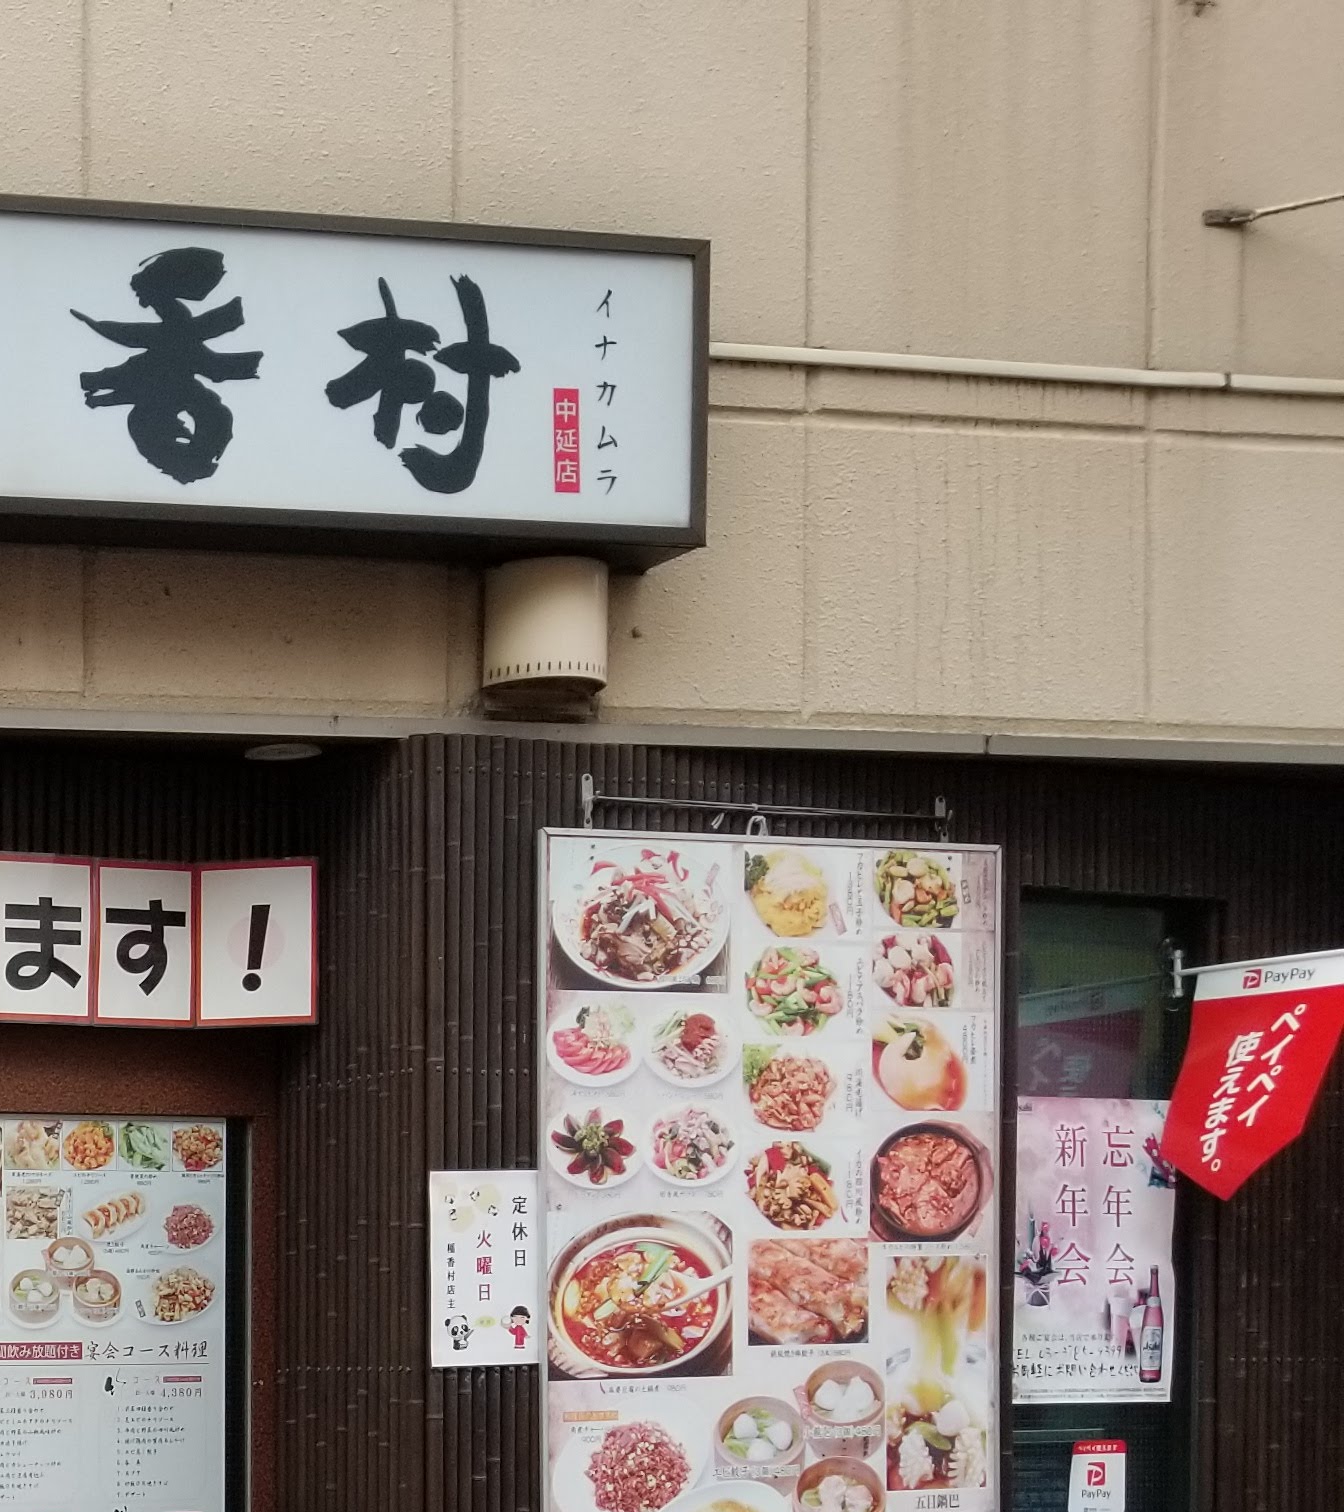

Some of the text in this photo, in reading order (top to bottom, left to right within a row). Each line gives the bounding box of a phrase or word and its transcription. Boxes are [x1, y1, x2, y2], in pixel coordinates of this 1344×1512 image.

[595, 289, 618, 495] イナカムラ
[555, 398, 579, 483] 中延店
[1264, 967, 1316, 985] PayPay
[1199, 1031, 1265, 1173] 使えます。
[1235, 1003, 1309, 1128] ペイペイ
[511, 1196, 528, 1267] 定休日
[1054, 1123, 1091, 1287] 新年会
[1101, 1125, 1135, 1286] 忘年会
[476, 1229, 493, 1302] 火曜日
[85, 1340, 209, 1360] 宴会コース料理
[1081, 1488, 1111, 1499] PayPay
